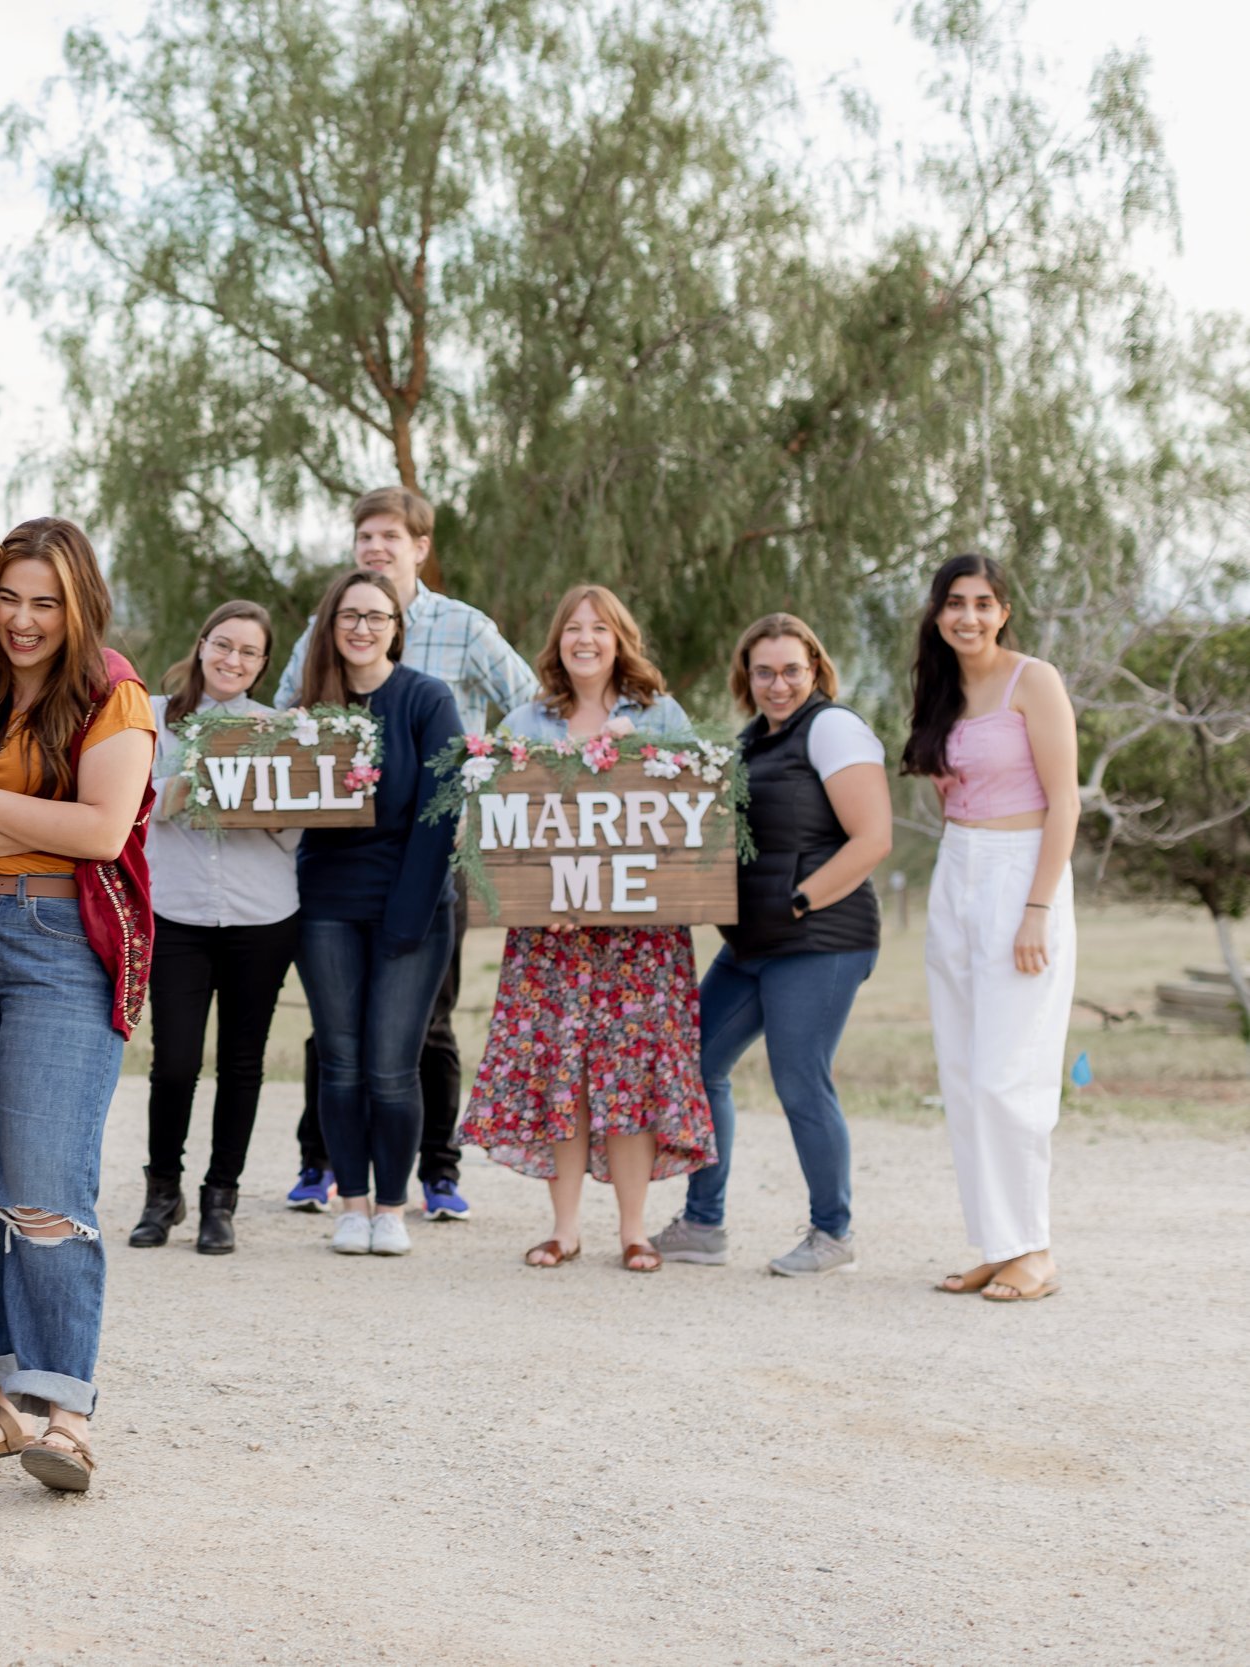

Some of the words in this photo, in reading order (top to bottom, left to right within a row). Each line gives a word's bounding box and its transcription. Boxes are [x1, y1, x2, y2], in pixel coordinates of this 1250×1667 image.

[205, 754, 365, 812] WILL
[479, 791, 717, 850] MARRY
[550, 854, 658, 913] ME
